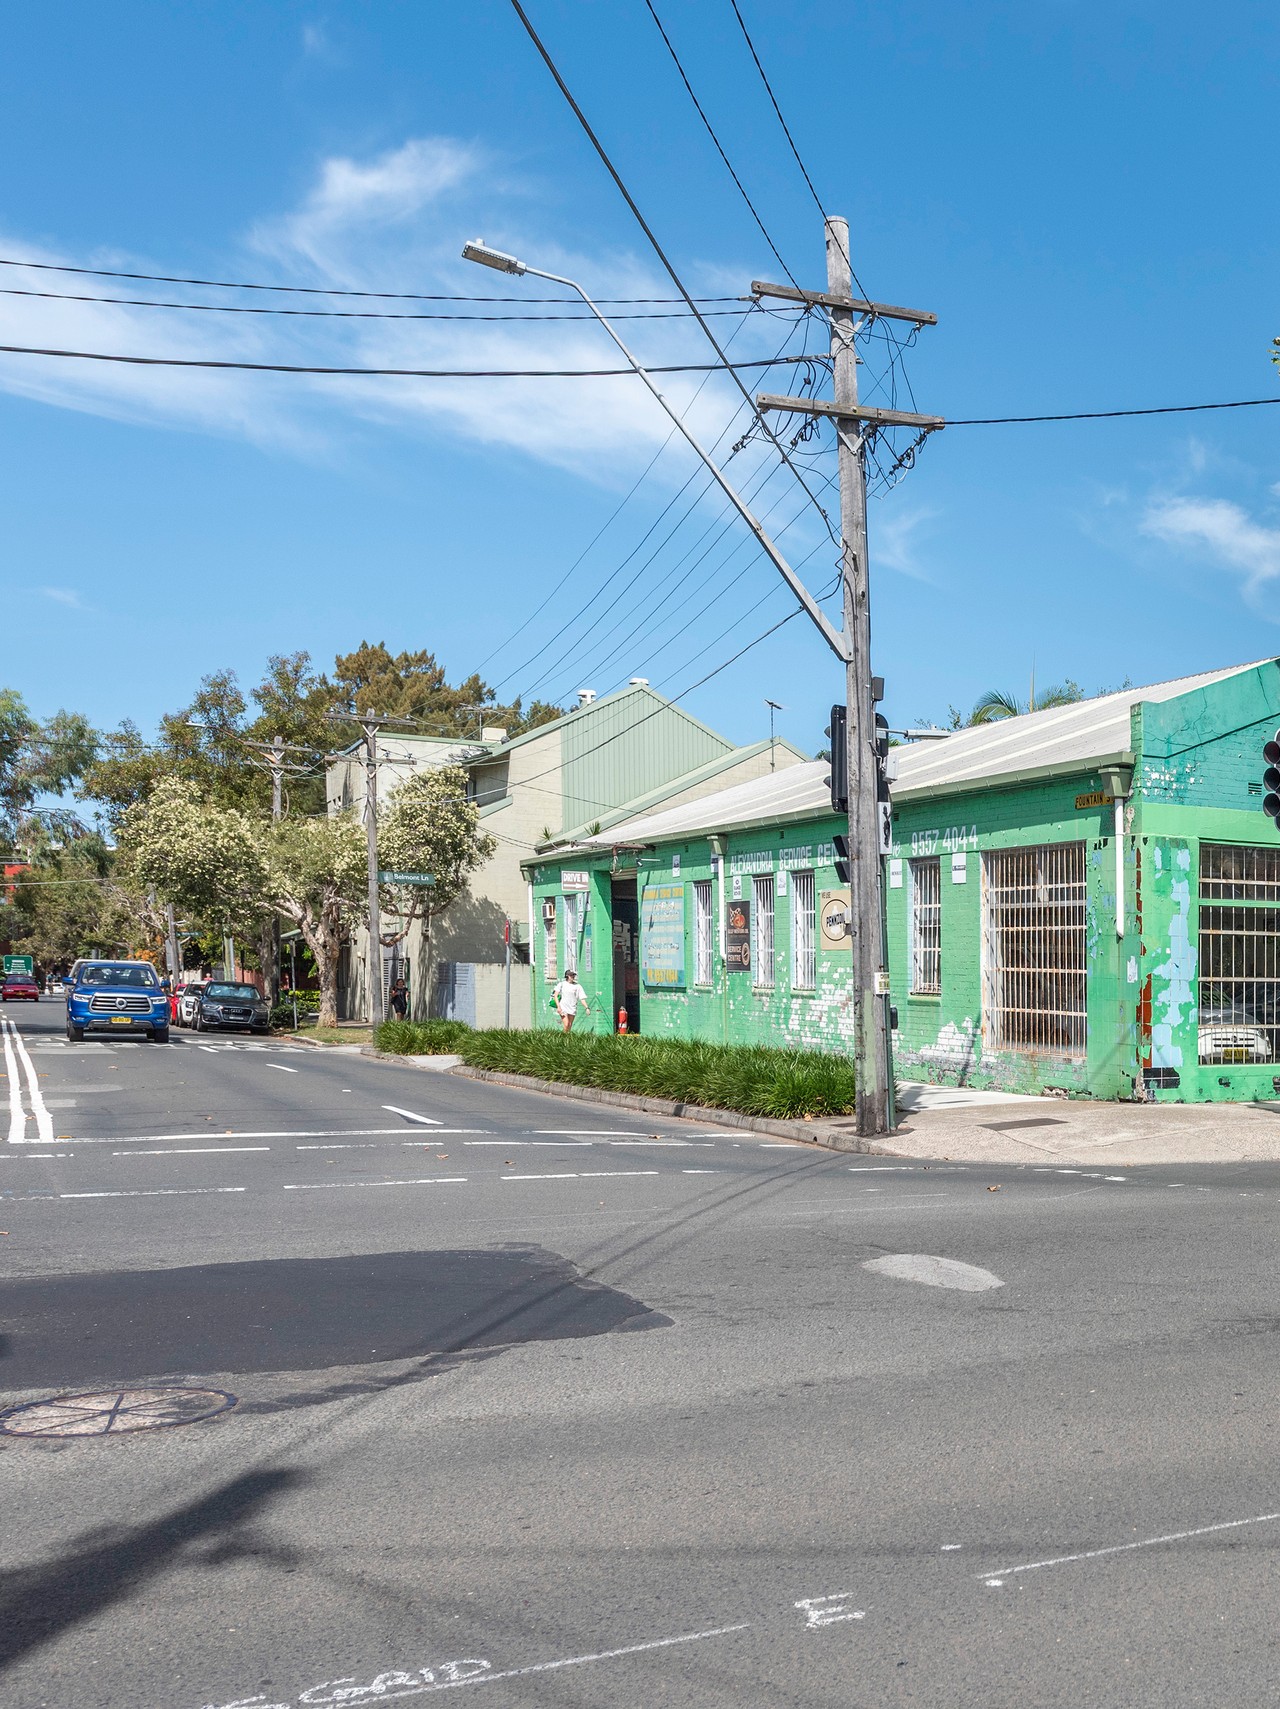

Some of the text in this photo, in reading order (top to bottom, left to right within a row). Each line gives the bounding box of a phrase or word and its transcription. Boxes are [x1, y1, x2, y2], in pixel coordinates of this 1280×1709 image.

[911, 829, 940, 856] 9557
[942, 824, 978, 852] 4044
[730, 850, 774, 875] ALEXANDRIA
[779, 845, 812, 871] SERVICE
[394, 873, 419, 881] Belmont
[563, 873, 589, 882] DRIVE IN
[728, 945, 742, 953] SERVICE
[728, 954, 742, 962] CENTRE
